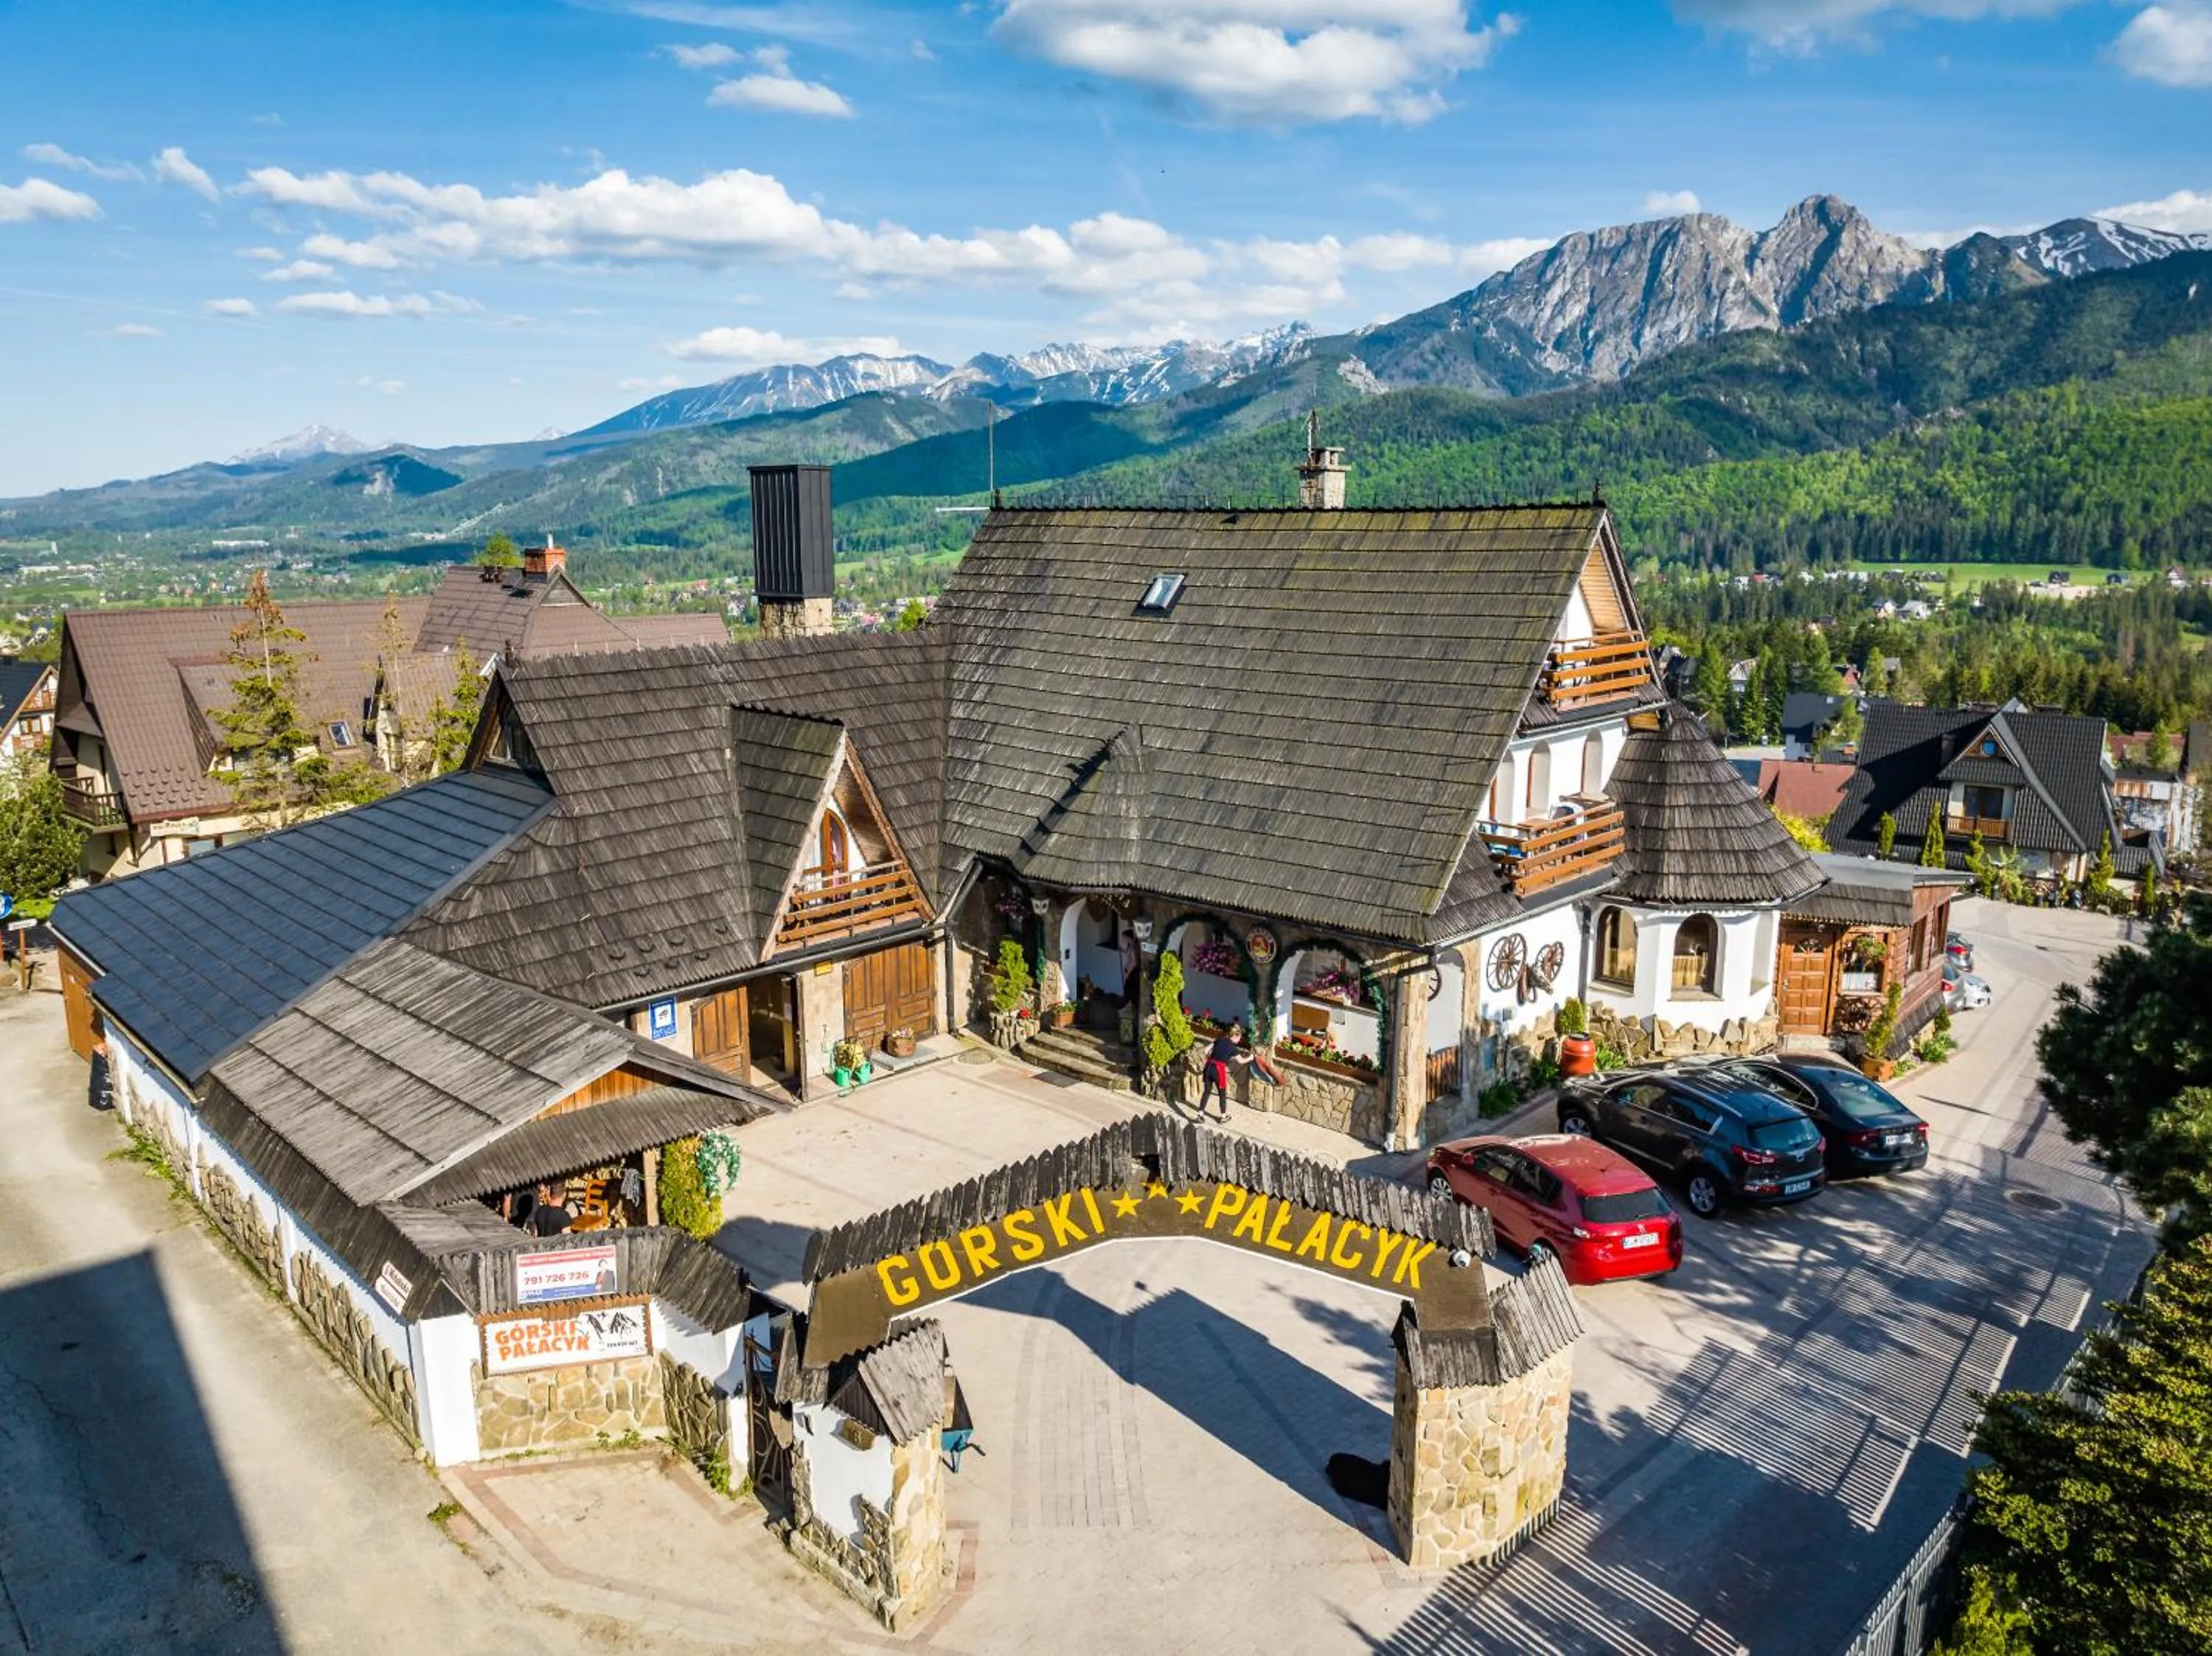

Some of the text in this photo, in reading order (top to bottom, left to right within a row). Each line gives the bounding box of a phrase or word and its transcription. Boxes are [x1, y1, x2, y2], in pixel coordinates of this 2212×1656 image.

[1204, 1183, 1437, 1289] PAŁACYK
[524, 1271, 589, 1285] 791 726 726
[495, 1321, 576, 1346] GÓRSKI
[499, 1335, 590, 1362] PAŁACYK
